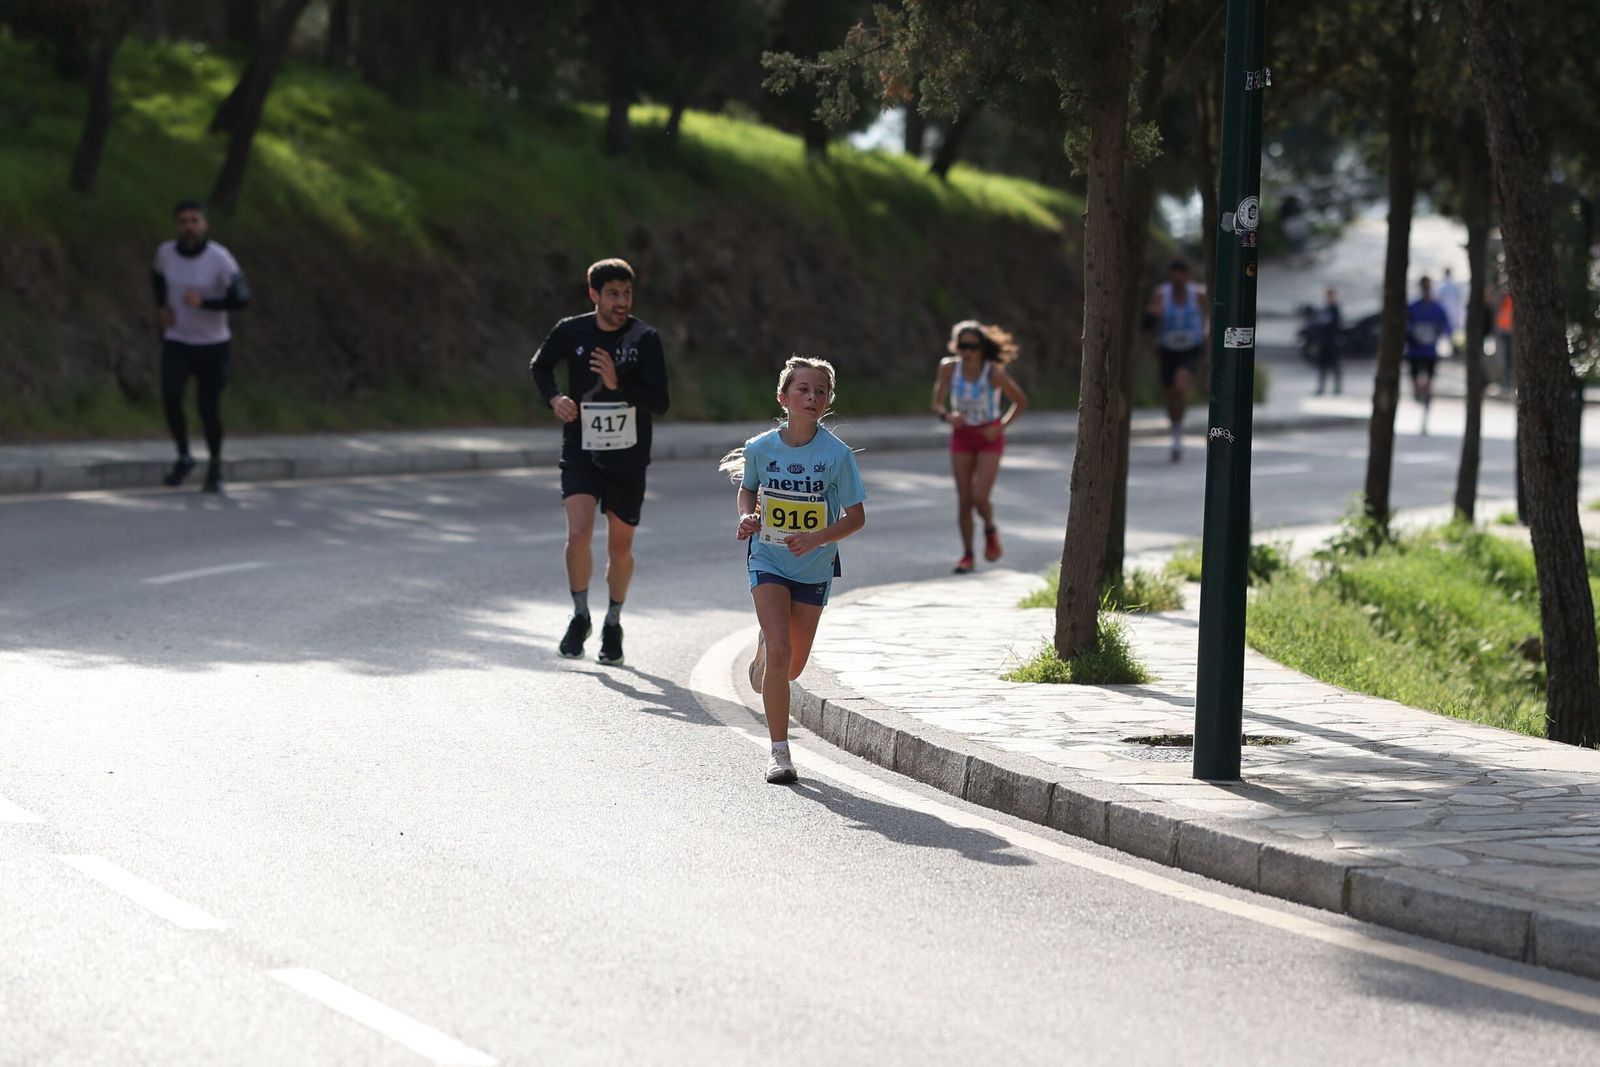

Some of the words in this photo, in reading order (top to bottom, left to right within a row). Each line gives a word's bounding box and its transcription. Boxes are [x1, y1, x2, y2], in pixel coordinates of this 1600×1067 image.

[592, 414, 628, 433] 417
[768, 476, 824, 493] nerja
[772, 507, 818, 530] 916
